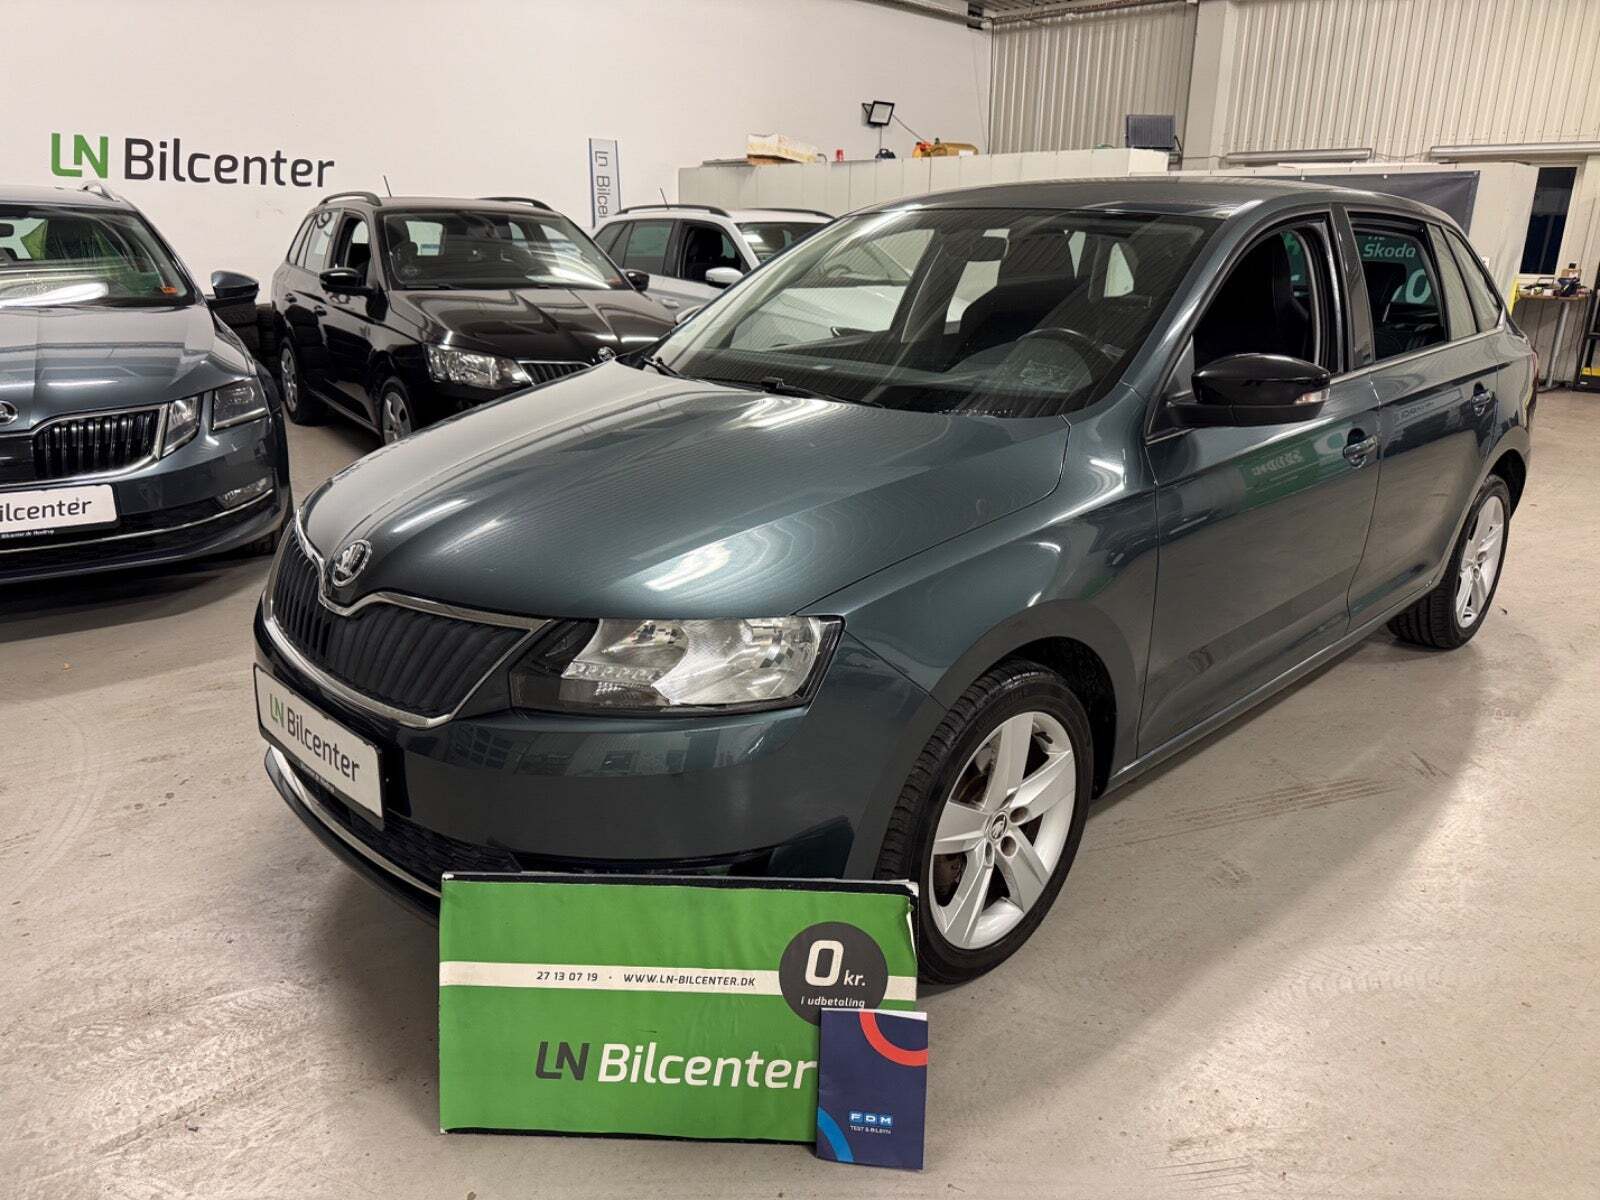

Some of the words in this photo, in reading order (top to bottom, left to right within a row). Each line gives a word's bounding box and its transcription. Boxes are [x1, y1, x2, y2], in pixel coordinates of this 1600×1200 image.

[51, 132, 108, 179] LN
[124, 138, 335, 188] Bilcenter
[1363, 243, 1416, 258] Skoda
[269, 693, 285, 728] LN
[287, 707, 361, 782] Bilcenter
[536, 971, 550, 981] 27
[554, 971, 566, 982] 13
[568, 972, 583, 982] 07
[587, 972, 599, 982] 19
[623, 973, 757, 987] WWW.LN-BILCENTER.DK
[805, 940, 844, 987] 0
[843, 969, 866, 986] kr.
[807, 996, 866, 1008] udbetaling
[535, 1041, 591, 1081] LN
[597, 1042, 818, 1089] Bilcenter
[850, 1112, 892, 1125] FDM
